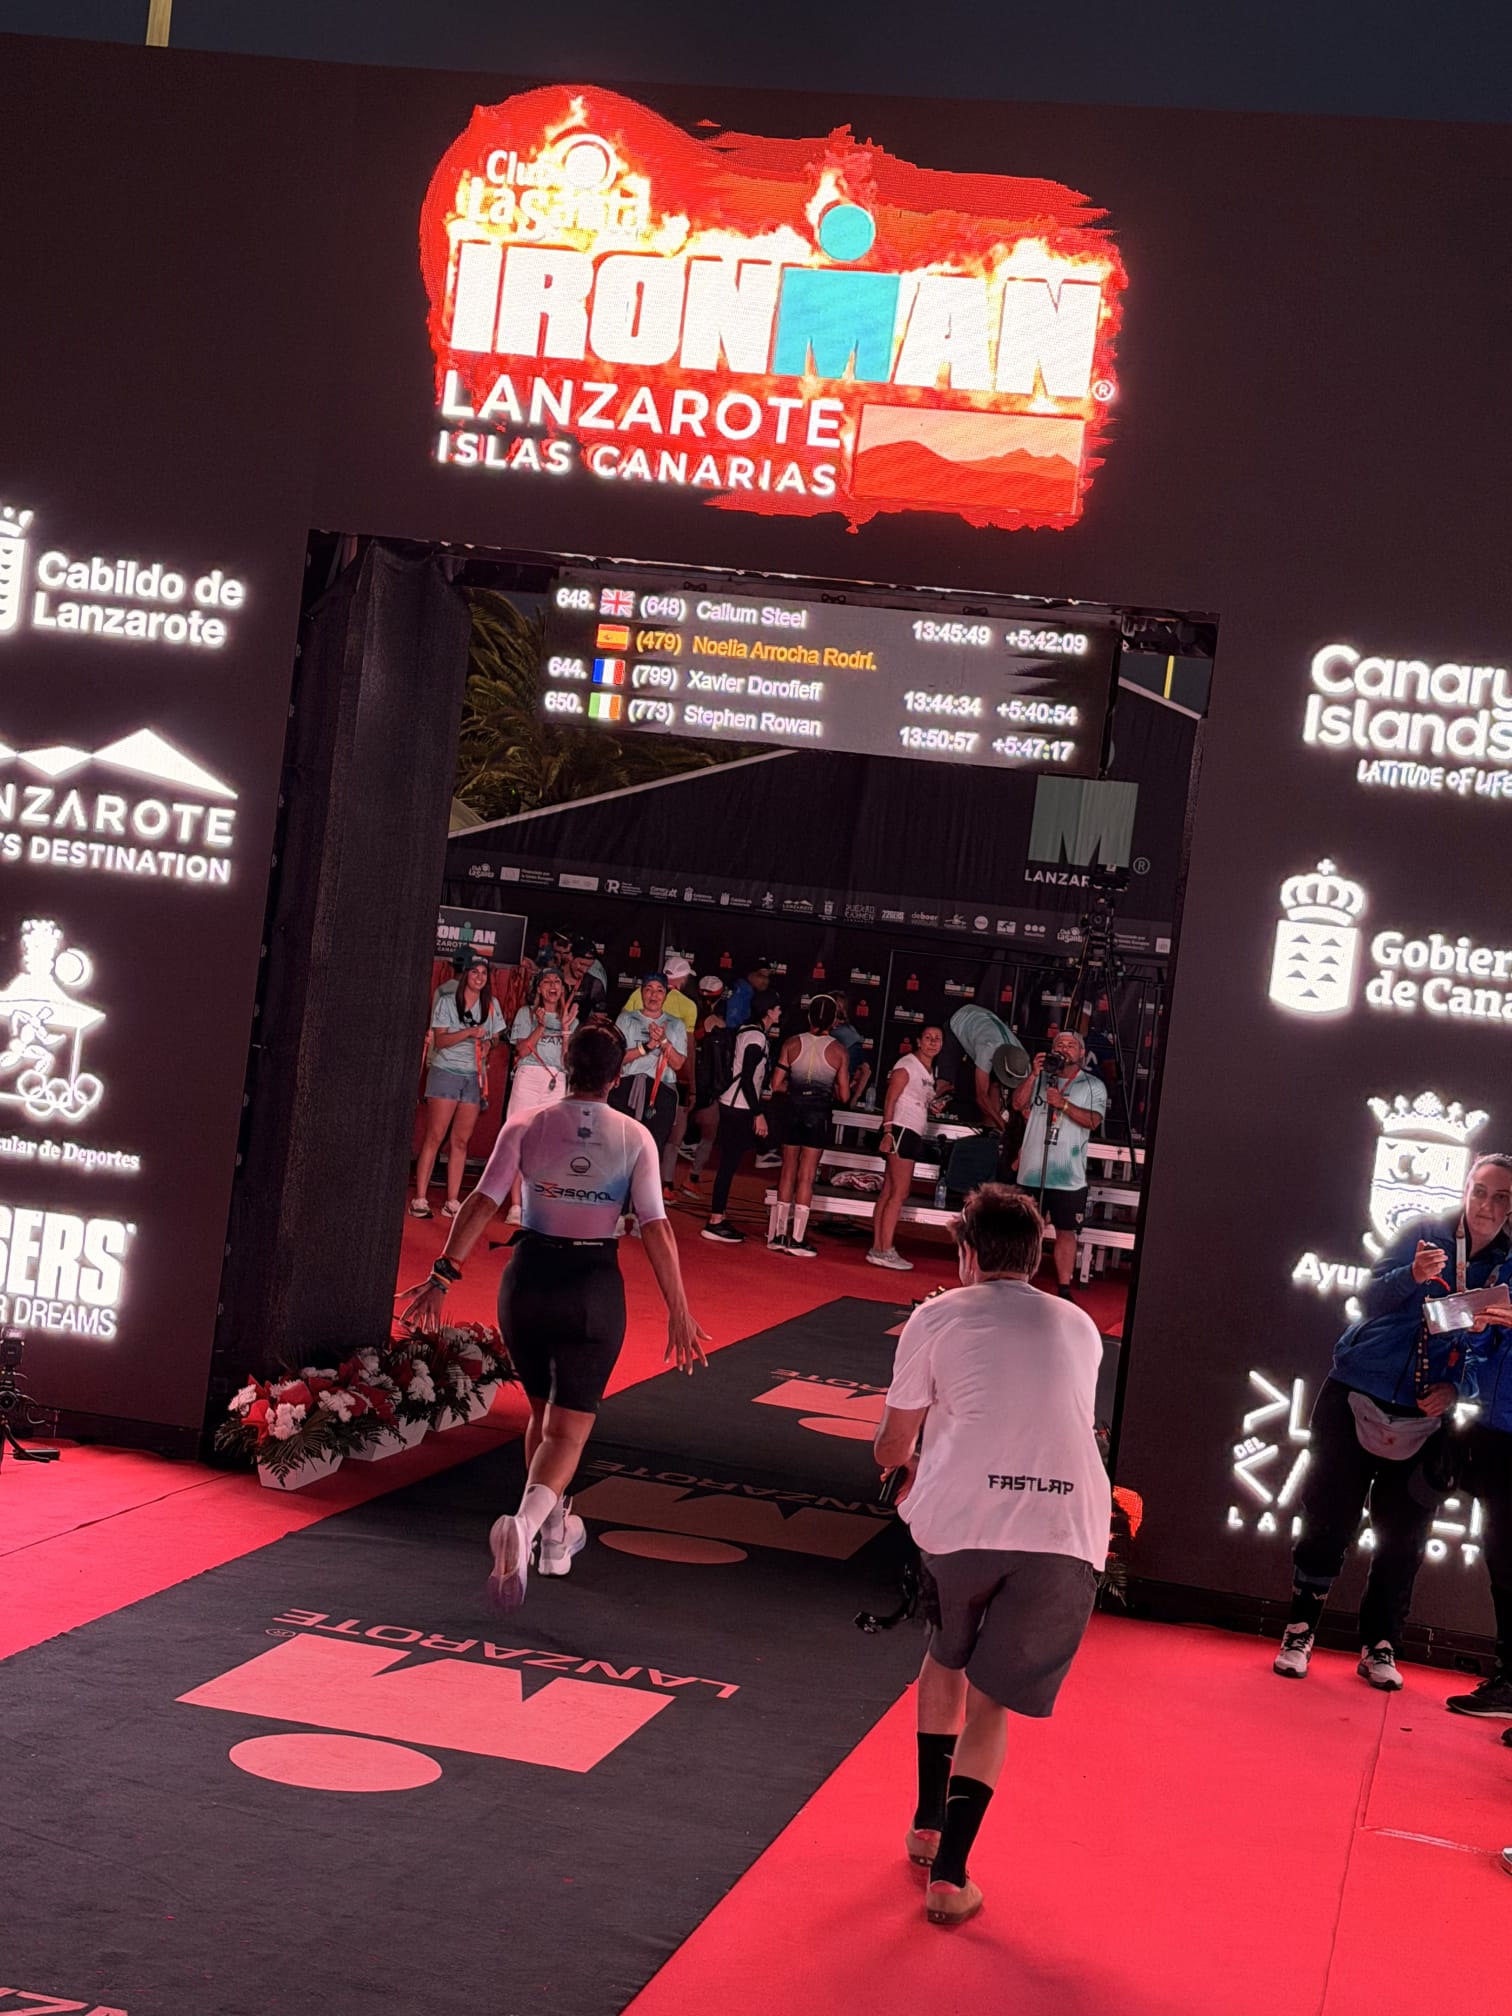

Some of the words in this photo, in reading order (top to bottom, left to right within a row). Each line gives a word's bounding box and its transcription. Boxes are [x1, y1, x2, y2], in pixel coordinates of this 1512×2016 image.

[449, 238, 1101, 398] IRONMAN
[440, 369, 844, 450] LANZAROTE
[438, 429, 571, 472] ISLAS
[591, 444, 837, 497] CANARIAS
[37, 549, 186, 601] Cabildo
[194, 569, 246, 607] de
[33, 591, 226, 646] Lanzarote
[556, 587, 595, 610] 648.
[639, 595, 686, 621] (648)
[696, 600, 757, 624] Callum
[761, 609, 807, 628] Steel
[912, 619, 992, 645] 13:45:49
[1006, 629, 1088, 655] +5:42:09
[635, 630, 682, 655] (479)
[691, 636, 750, 657] Noelia
[750, 641, 819, 665] Arrocha
[548, 656, 587, 679] 644.
[631, 665, 678, 690] (799)
[687, 669, 745, 692] Xavier
[903, 690, 982, 716] 13:44:34
[997, 701, 1079, 726] +5:40:54
[544, 691, 583, 713] 650.
[628, 699, 675, 724] (773)
[683, 705, 757, 731] Stephen
[760, 712, 821, 736] Rowan
[899, 726, 978, 752] 13:50:57
[992, 736, 1075, 762] +5:47:17
[1303, 693, 1512, 761] Islands
[1357, 758, 1445, 790] LATITUDE
[30, 835, 231, 884] DESTINATION
[1024, 868, 1128, 892] LANZAR
[1371, 931, 1512, 977] Gobier
[1366, 969, 1418, 1008] de
[39, 1139, 61, 1158] de
[62, 1141, 140, 1170] Deportes
[14, 1296, 117, 1336] DREAMS
[1233, 1436, 1267, 1460] DEL
[583, 1458, 898, 1516] ANZAROTE
[987, 1474, 1075, 1495] FASTLAP
[272, 1607, 741, 1699] LANZAROTE
